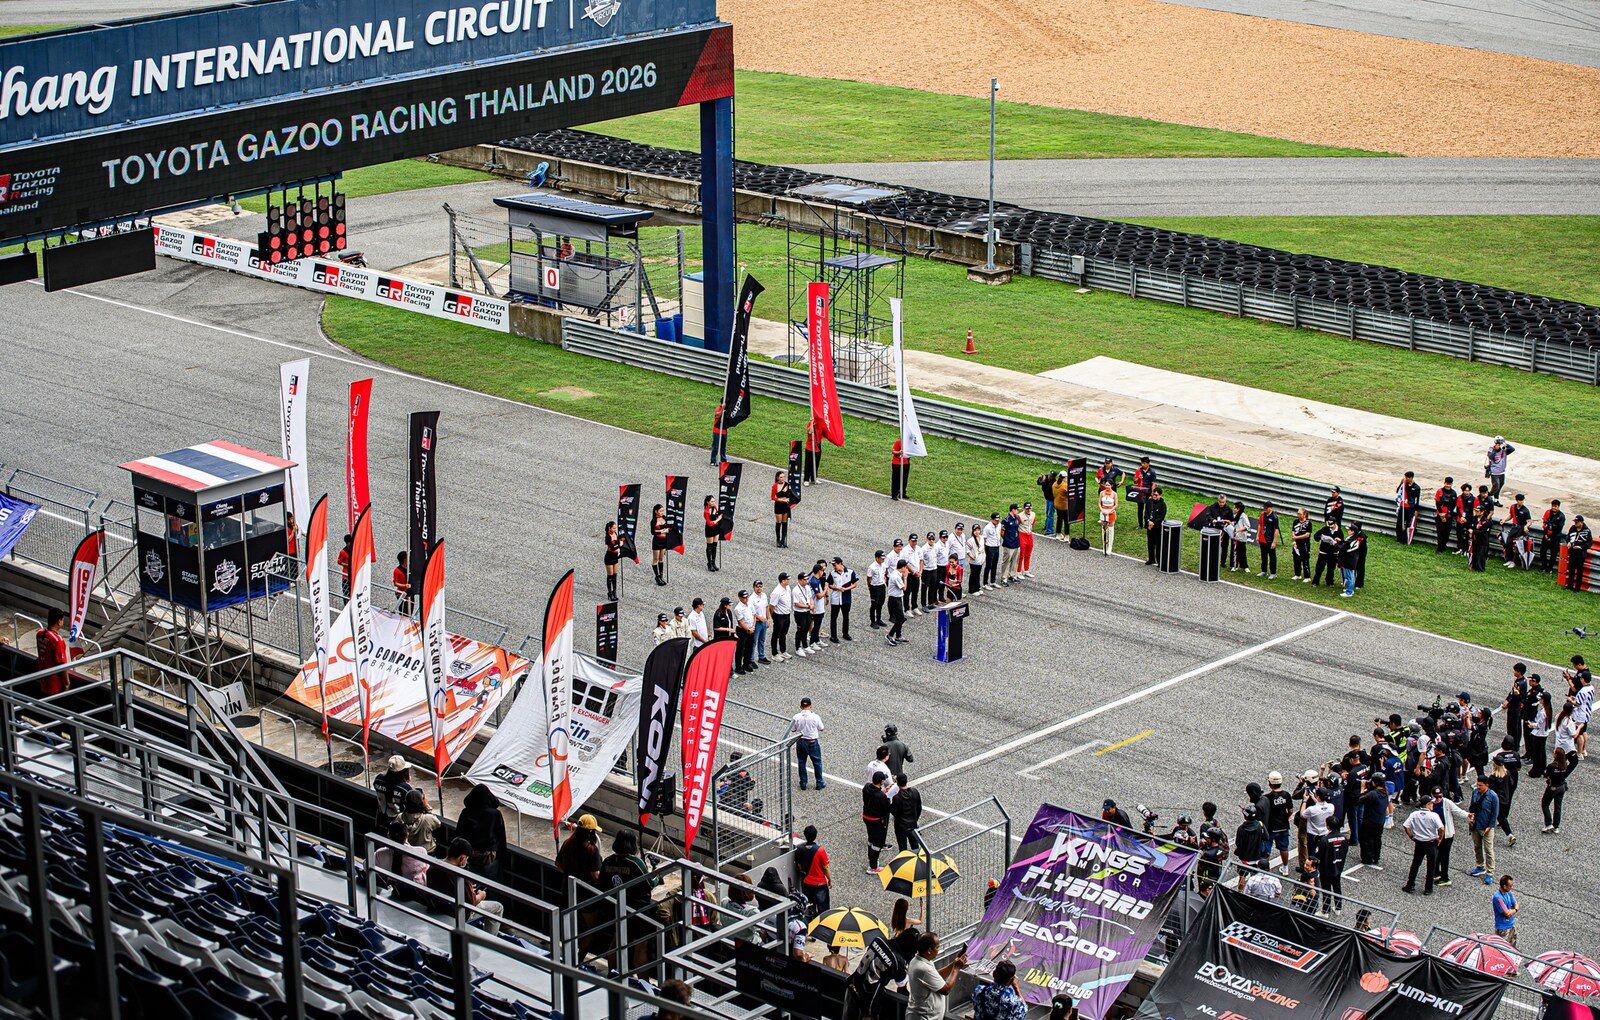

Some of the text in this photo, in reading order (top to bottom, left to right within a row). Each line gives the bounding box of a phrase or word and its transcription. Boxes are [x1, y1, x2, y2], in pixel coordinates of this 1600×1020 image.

[131, 17, 415, 97] INTERNATIONAL
[424, 0, 554, 46] CIRCUIT
[102, 62, 658, 189] TOYOTA GAZOO RACING THAILAND 2026
[13, 167, 61, 181] TOYOTA
[11, 176, 56, 191] GAZOO
[10, 186, 54, 200] Racing
[160, 235, 183, 246] GAZOO
[161, 229, 185, 240] TOYOTA
[159, 241, 182, 252] Racing
[192, 244, 214, 258] GR
[216, 247, 239, 258] GAZOO
[217, 241, 242, 252] TOYOTA
[215, 253, 238, 265] Racing
[273, 268, 298, 280] Racing
[314, 272, 338, 286] GR
[340, 275, 366, 286] GAZOO
[341, 270, 369, 281] TOYOTA
[547, 269, 556, 287] 0
[339, 281, 365, 294] Racing
[376, 285, 402, 300] GR
[406, 284, 435, 296] TOYOTA
[403, 297, 430, 309] Racing
[404, 290, 432, 302] GAZOO
[443, 301, 470, 317] GR
[473, 305, 502, 317] GAZOO
[474, 299, 505, 311] TOYOTA
[472, 312, 501, 325] Racing
[286, 399, 294, 441] TOYOTA
[251, 557, 284, 572] START
[370, 659, 420, 682] BRAKES
[686, 690, 699, 745] BRAKE
[688, 689, 720, 828] RUNSTOP
[1047, 832, 1152, 876] KINGS
[1077, 859, 1143, 888] MOTOR
[1020, 865, 1155, 921] FLYBOARD
